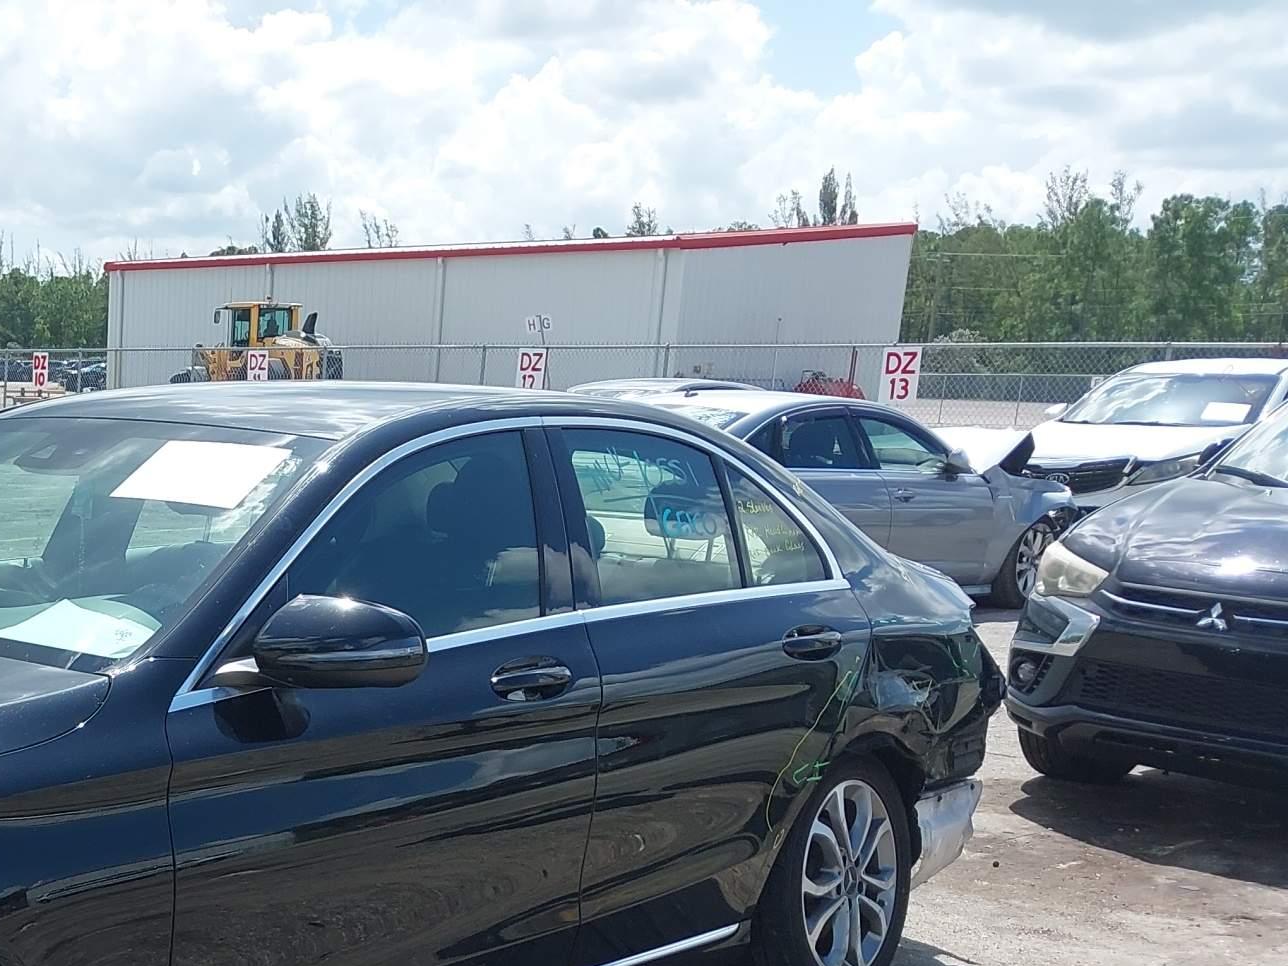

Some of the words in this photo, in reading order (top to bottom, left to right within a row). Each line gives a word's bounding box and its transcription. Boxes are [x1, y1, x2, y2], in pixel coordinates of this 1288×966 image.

[527, 319, 536, 331] H
[542, 317, 551, 329] G
[34, 354, 47, 370] DZ
[249, 353, 267, 371] DZ
[520, 352, 544, 372] DZ
[885, 351, 918, 375] DZ
[889, 377, 910, 400] 13
